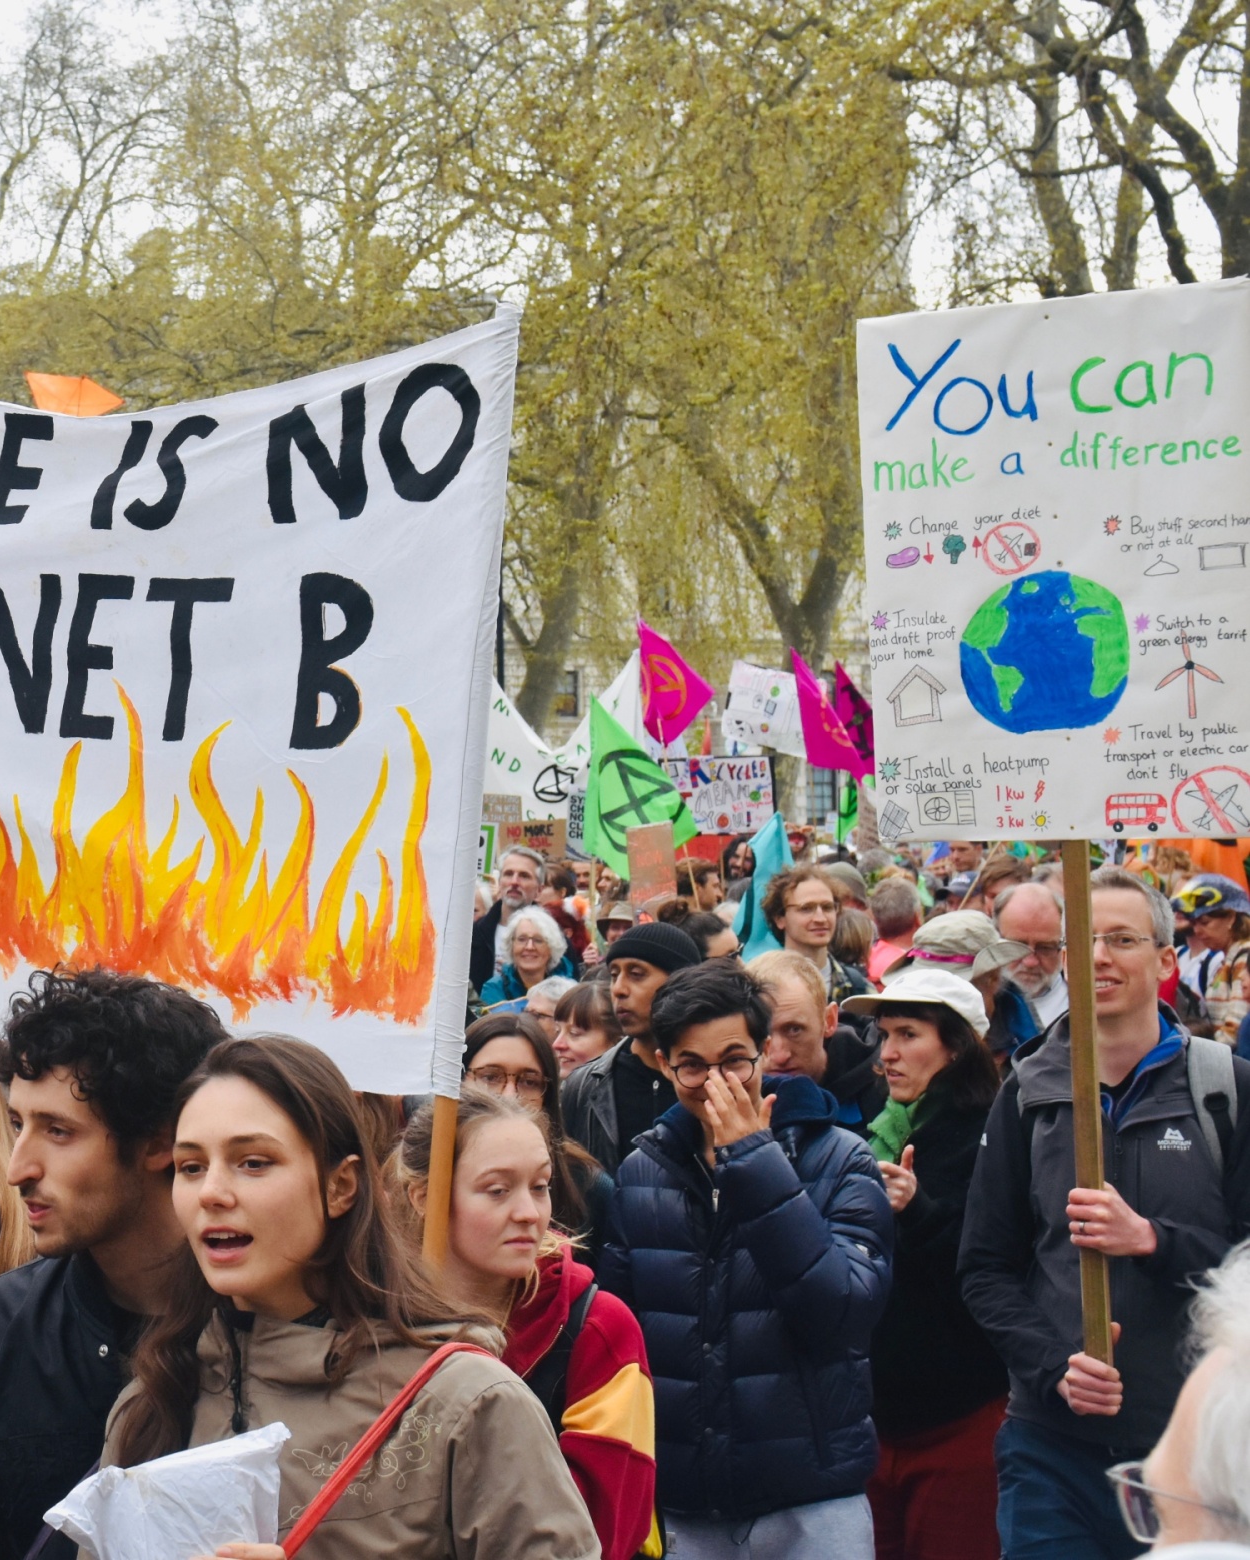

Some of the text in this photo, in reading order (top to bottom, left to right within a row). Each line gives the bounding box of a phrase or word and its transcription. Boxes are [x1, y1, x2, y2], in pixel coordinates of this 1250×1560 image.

[90, 414, 218, 531] IS
[267, 362, 480, 524] NO
[874, 430, 1242, 491] make a difference
[909, 505, 1042, 536] Change your diet
[1131, 515, 1154, 539] Buy
[1158, 517, 1183, 533] stuff
[1188, 514, 1227, 530] second
[1120, 533, 1193, 552] or not at all
[892, 609, 947, 628] Insulate
[1156, 614, 1194, 632] Switch
[1197, 613, 1211, 626] to
[870, 625, 956, 647] and draft proof
[1139, 628, 1247, 655] green energy tarrif
[289, 571, 373, 750] B
[870, 647, 935, 670] your home
[1128, 722, 1238, 743] Travel by public
[1104, 744, 1249, 766] transport or electric car
[903, 755, 955, 781] Install
[963, 763, 973, 775] a
[1127, 763, 1188, 780] don't fly
[885, 777, 982, 795] or solar panels
[507, 823, 554, 838] NO MORE
[996, 816, 1004, 828] 3
